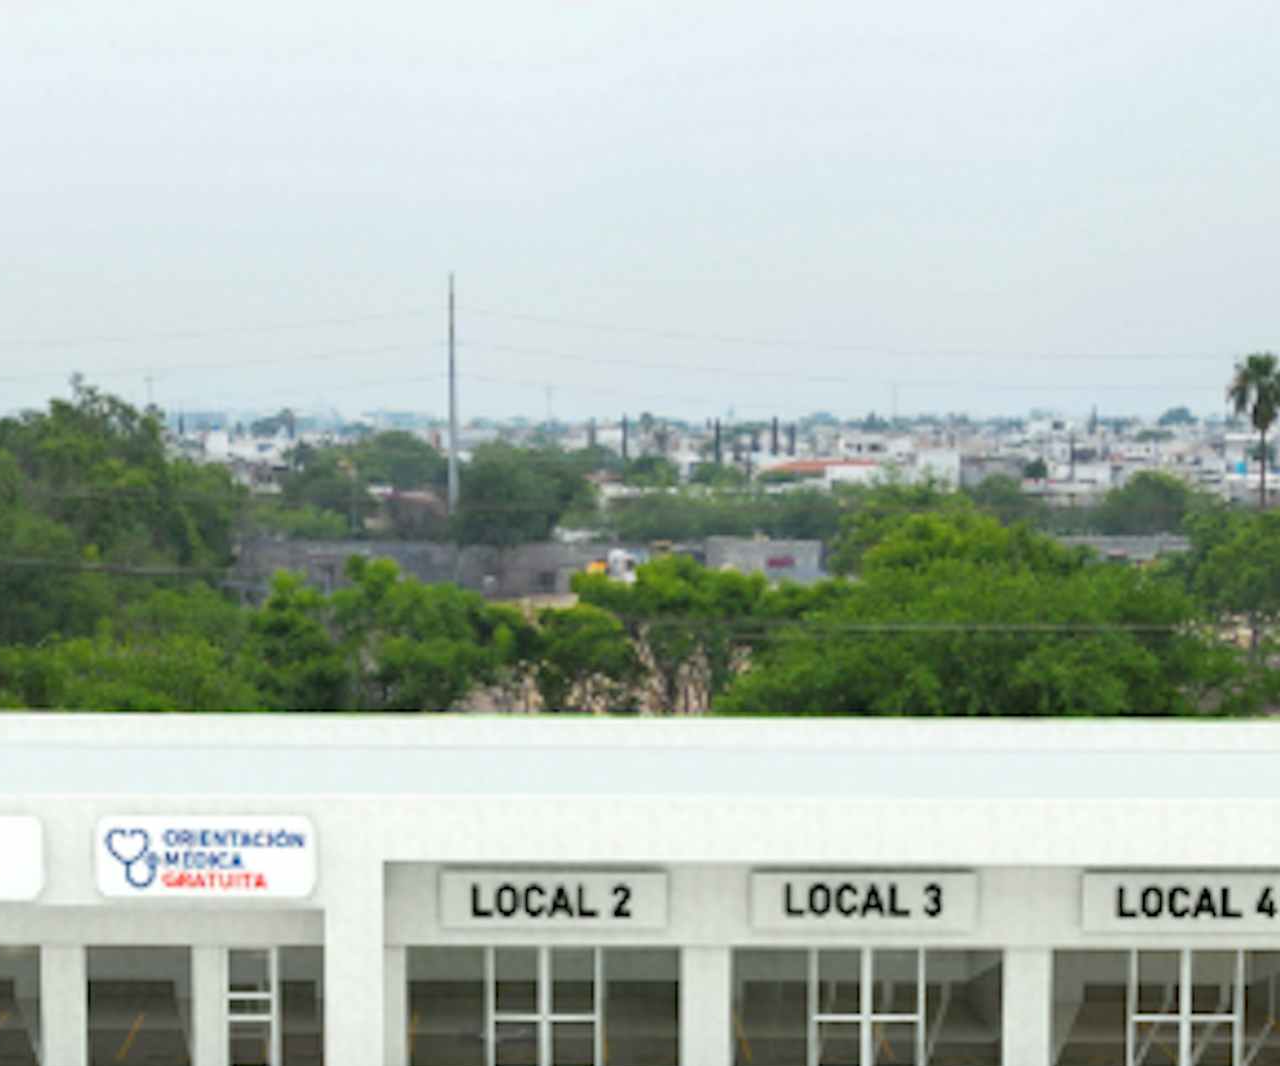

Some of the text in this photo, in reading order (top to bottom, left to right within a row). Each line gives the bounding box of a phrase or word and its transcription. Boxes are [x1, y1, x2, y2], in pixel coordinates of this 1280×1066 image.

[162, 826, 307, 849] ORIENTACIÓN
[160, 870, 269, 890] GRATUITA
[471, 882, 632, 918] LOCAL 2
[784, 882, 943, 918] LOCAL 3
[1117, 884, 1278, 919] LOCAL 4
